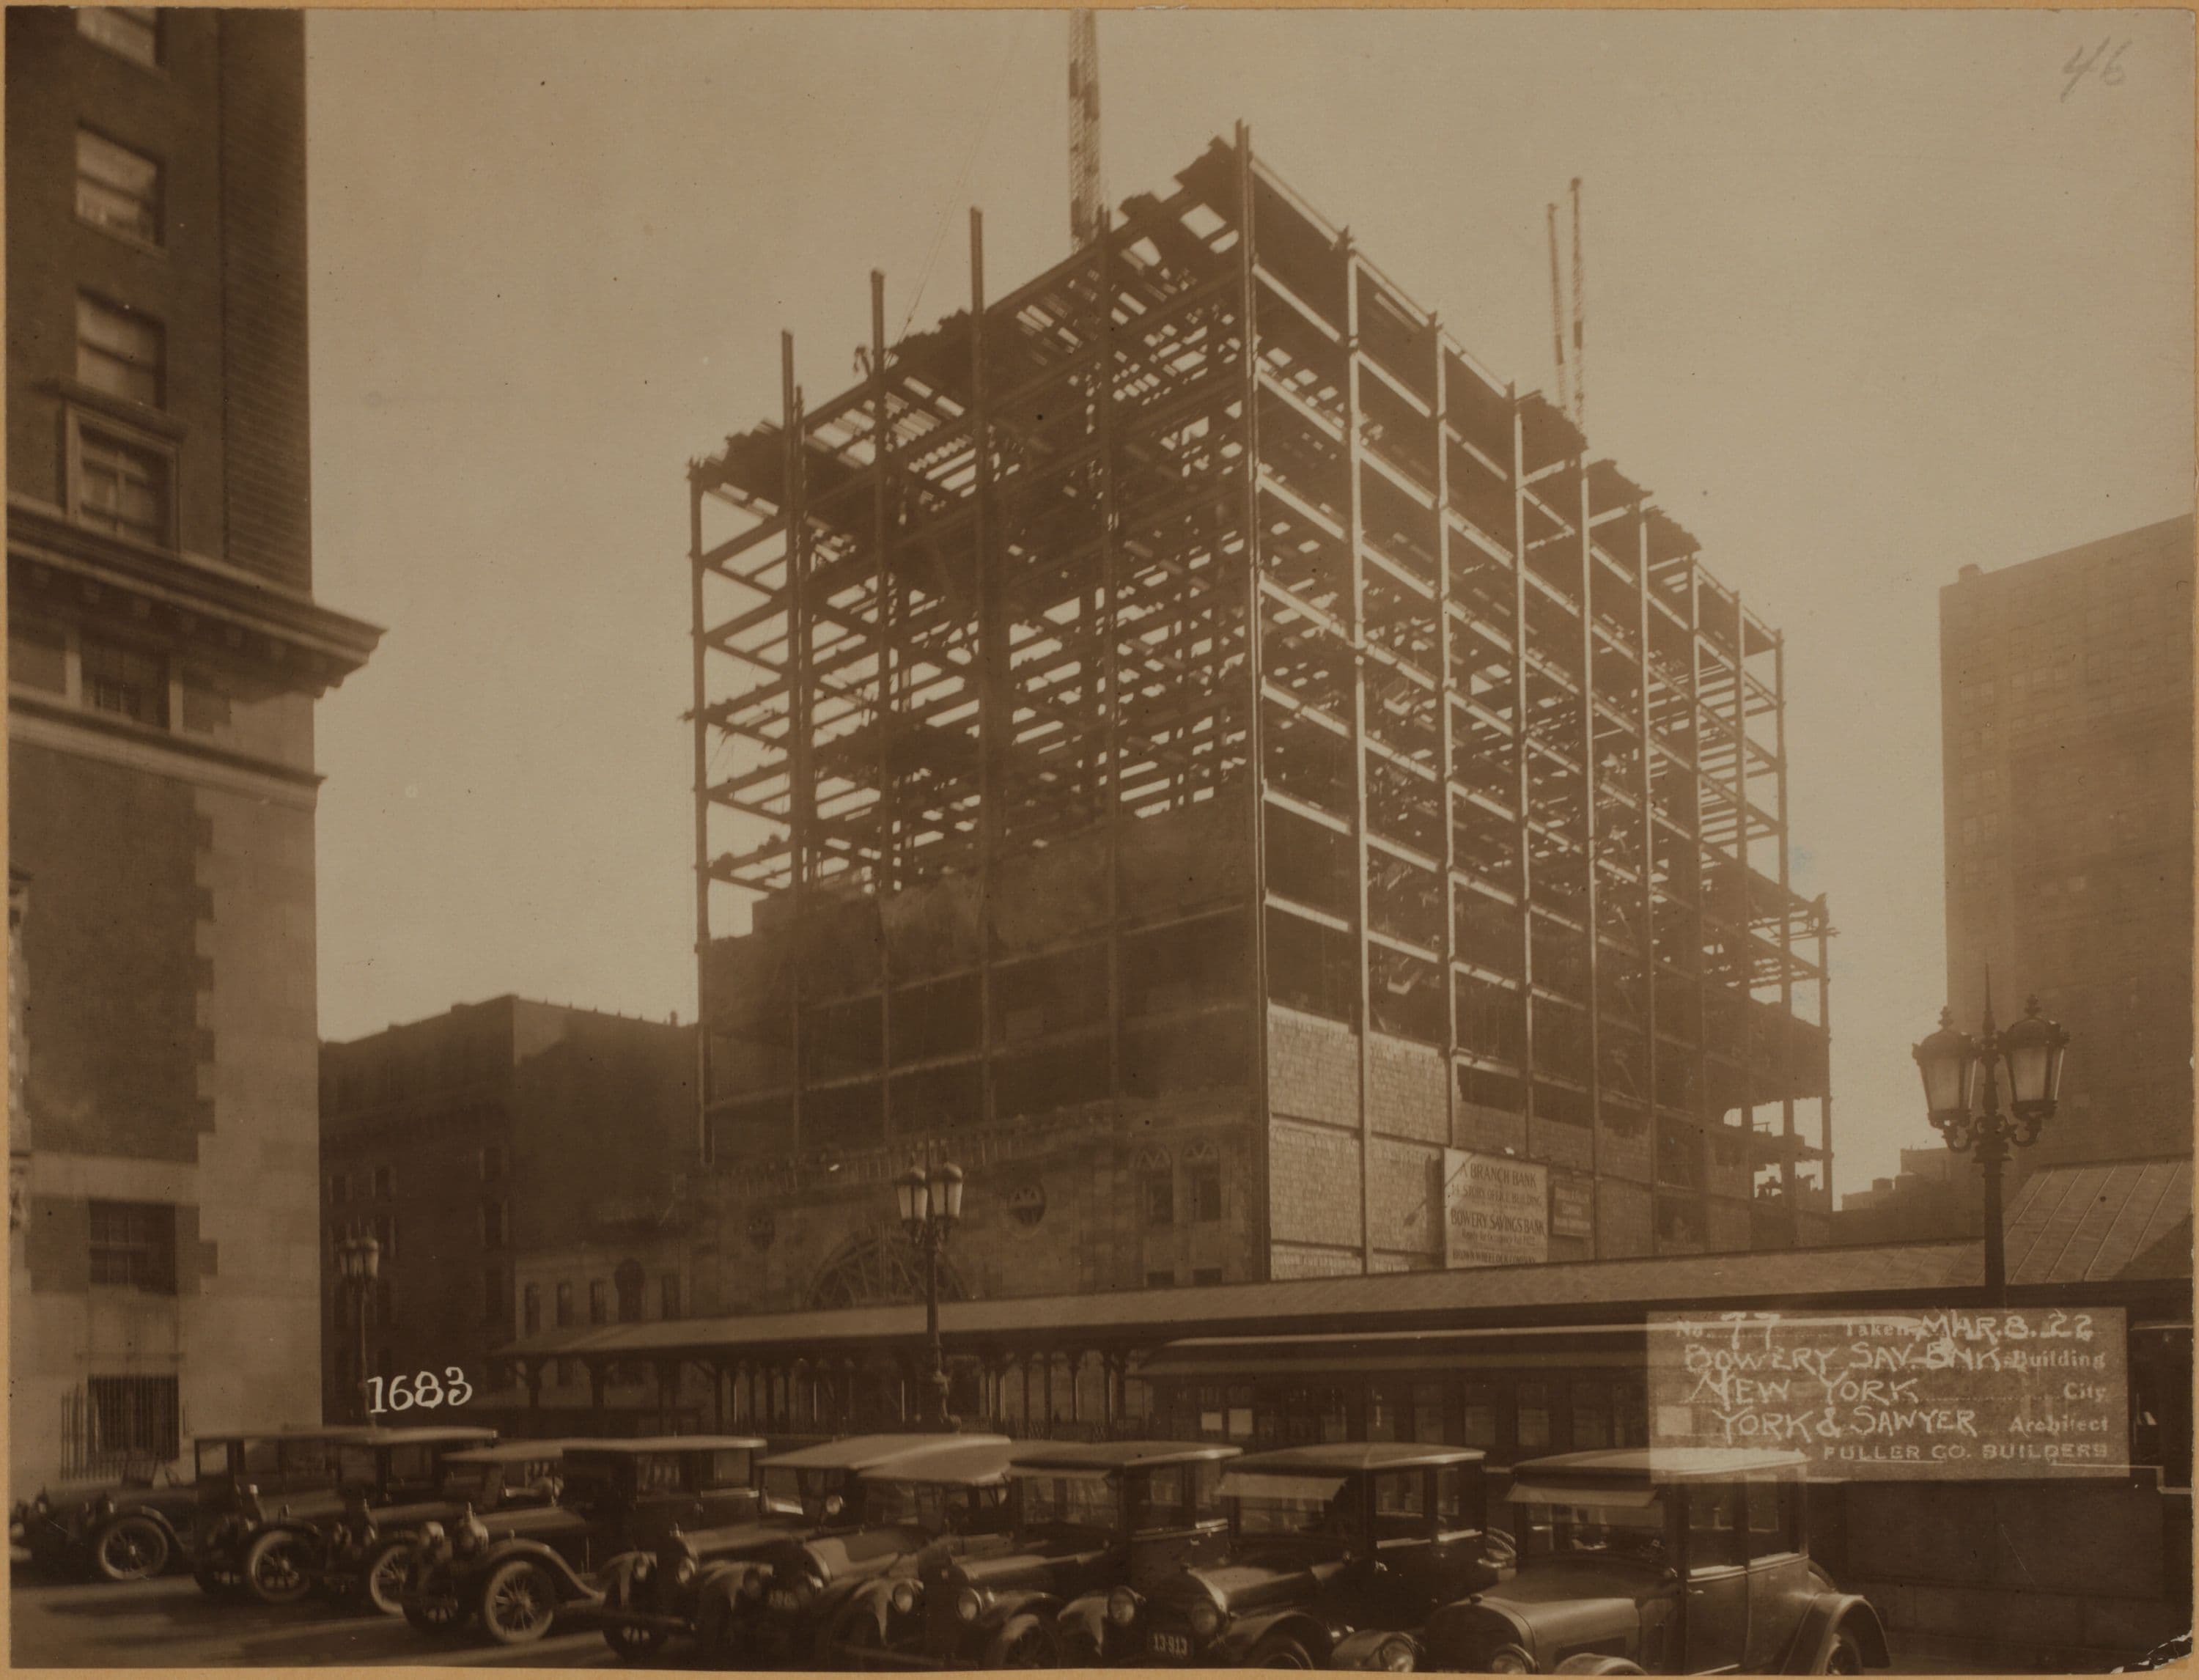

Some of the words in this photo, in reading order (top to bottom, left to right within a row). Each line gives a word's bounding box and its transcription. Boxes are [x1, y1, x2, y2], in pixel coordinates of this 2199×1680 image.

[2060, 36, 2132, 103] 46
[1470, 1163, 1510, 1185] BRANCH
[1512, 1171, 1537, 1189] BANK
[1451, 1207, 1488, 1228] BOWERY
[1489, 1212, 1523, 1233] SAVINGS
[1524, 1217, 1547, 1237] BANK
